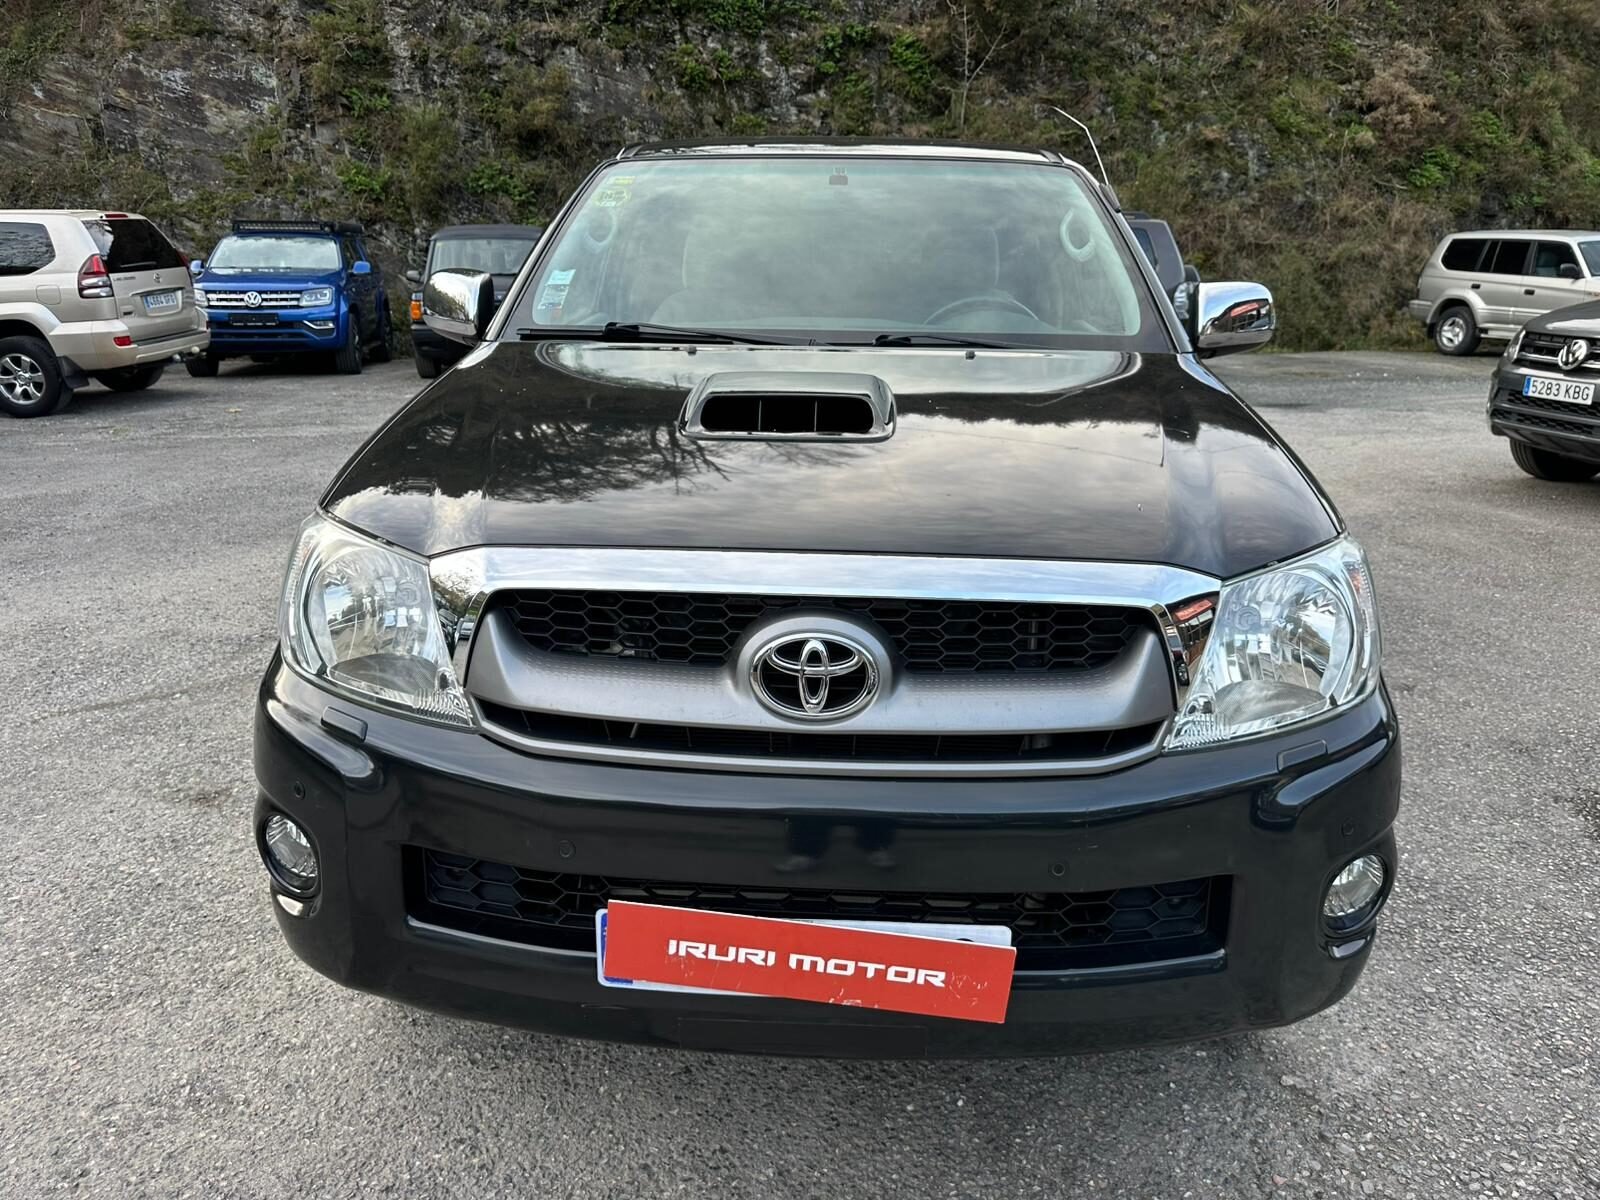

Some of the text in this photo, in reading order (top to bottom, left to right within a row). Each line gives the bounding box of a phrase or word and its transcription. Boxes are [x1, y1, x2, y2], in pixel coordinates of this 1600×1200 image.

[1531, 380, 1590, 401] 5283 KBG
[668, 939, 946, 987] IRURI MOTOR
